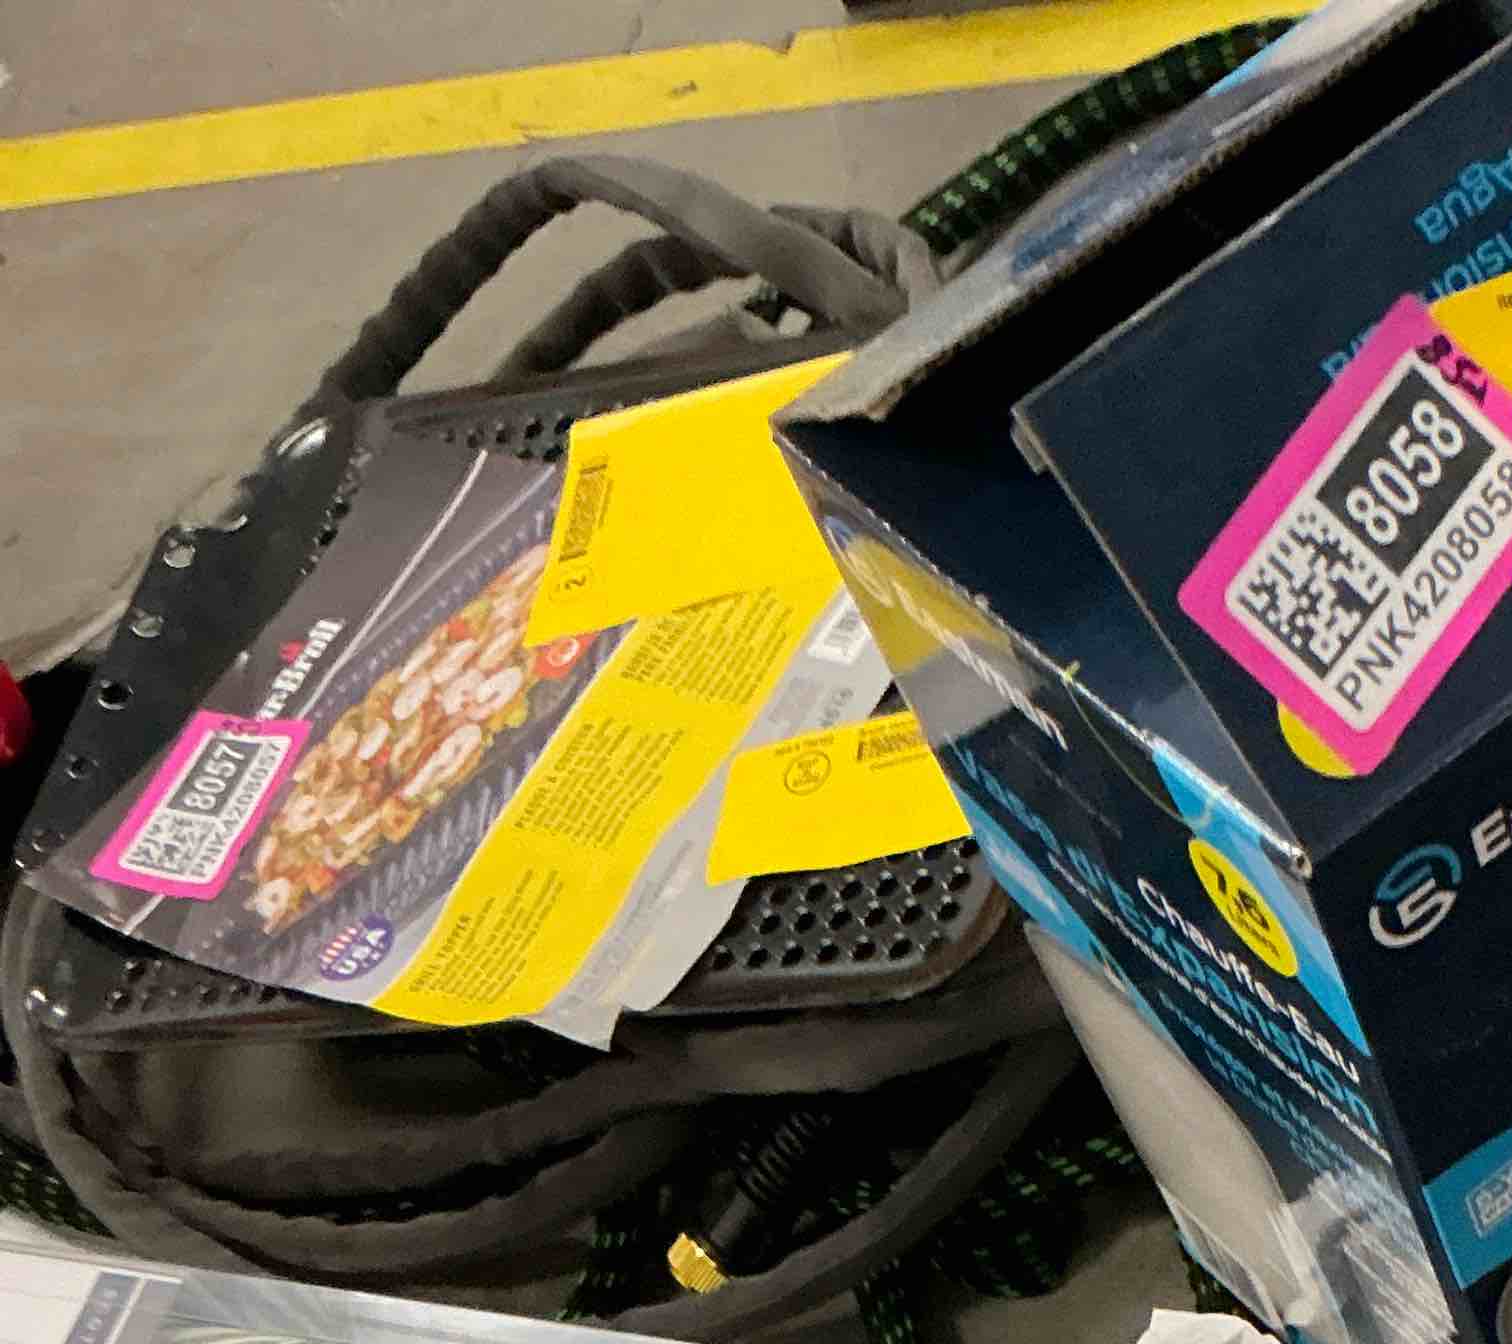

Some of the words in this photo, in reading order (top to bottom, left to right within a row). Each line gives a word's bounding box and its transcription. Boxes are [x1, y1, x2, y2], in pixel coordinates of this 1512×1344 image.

[1347, 401, 1468, 546] 8058
[184, 743, 245, 811] 8057
[1137, 877, 1360, 1082] Chauffe-Eau
